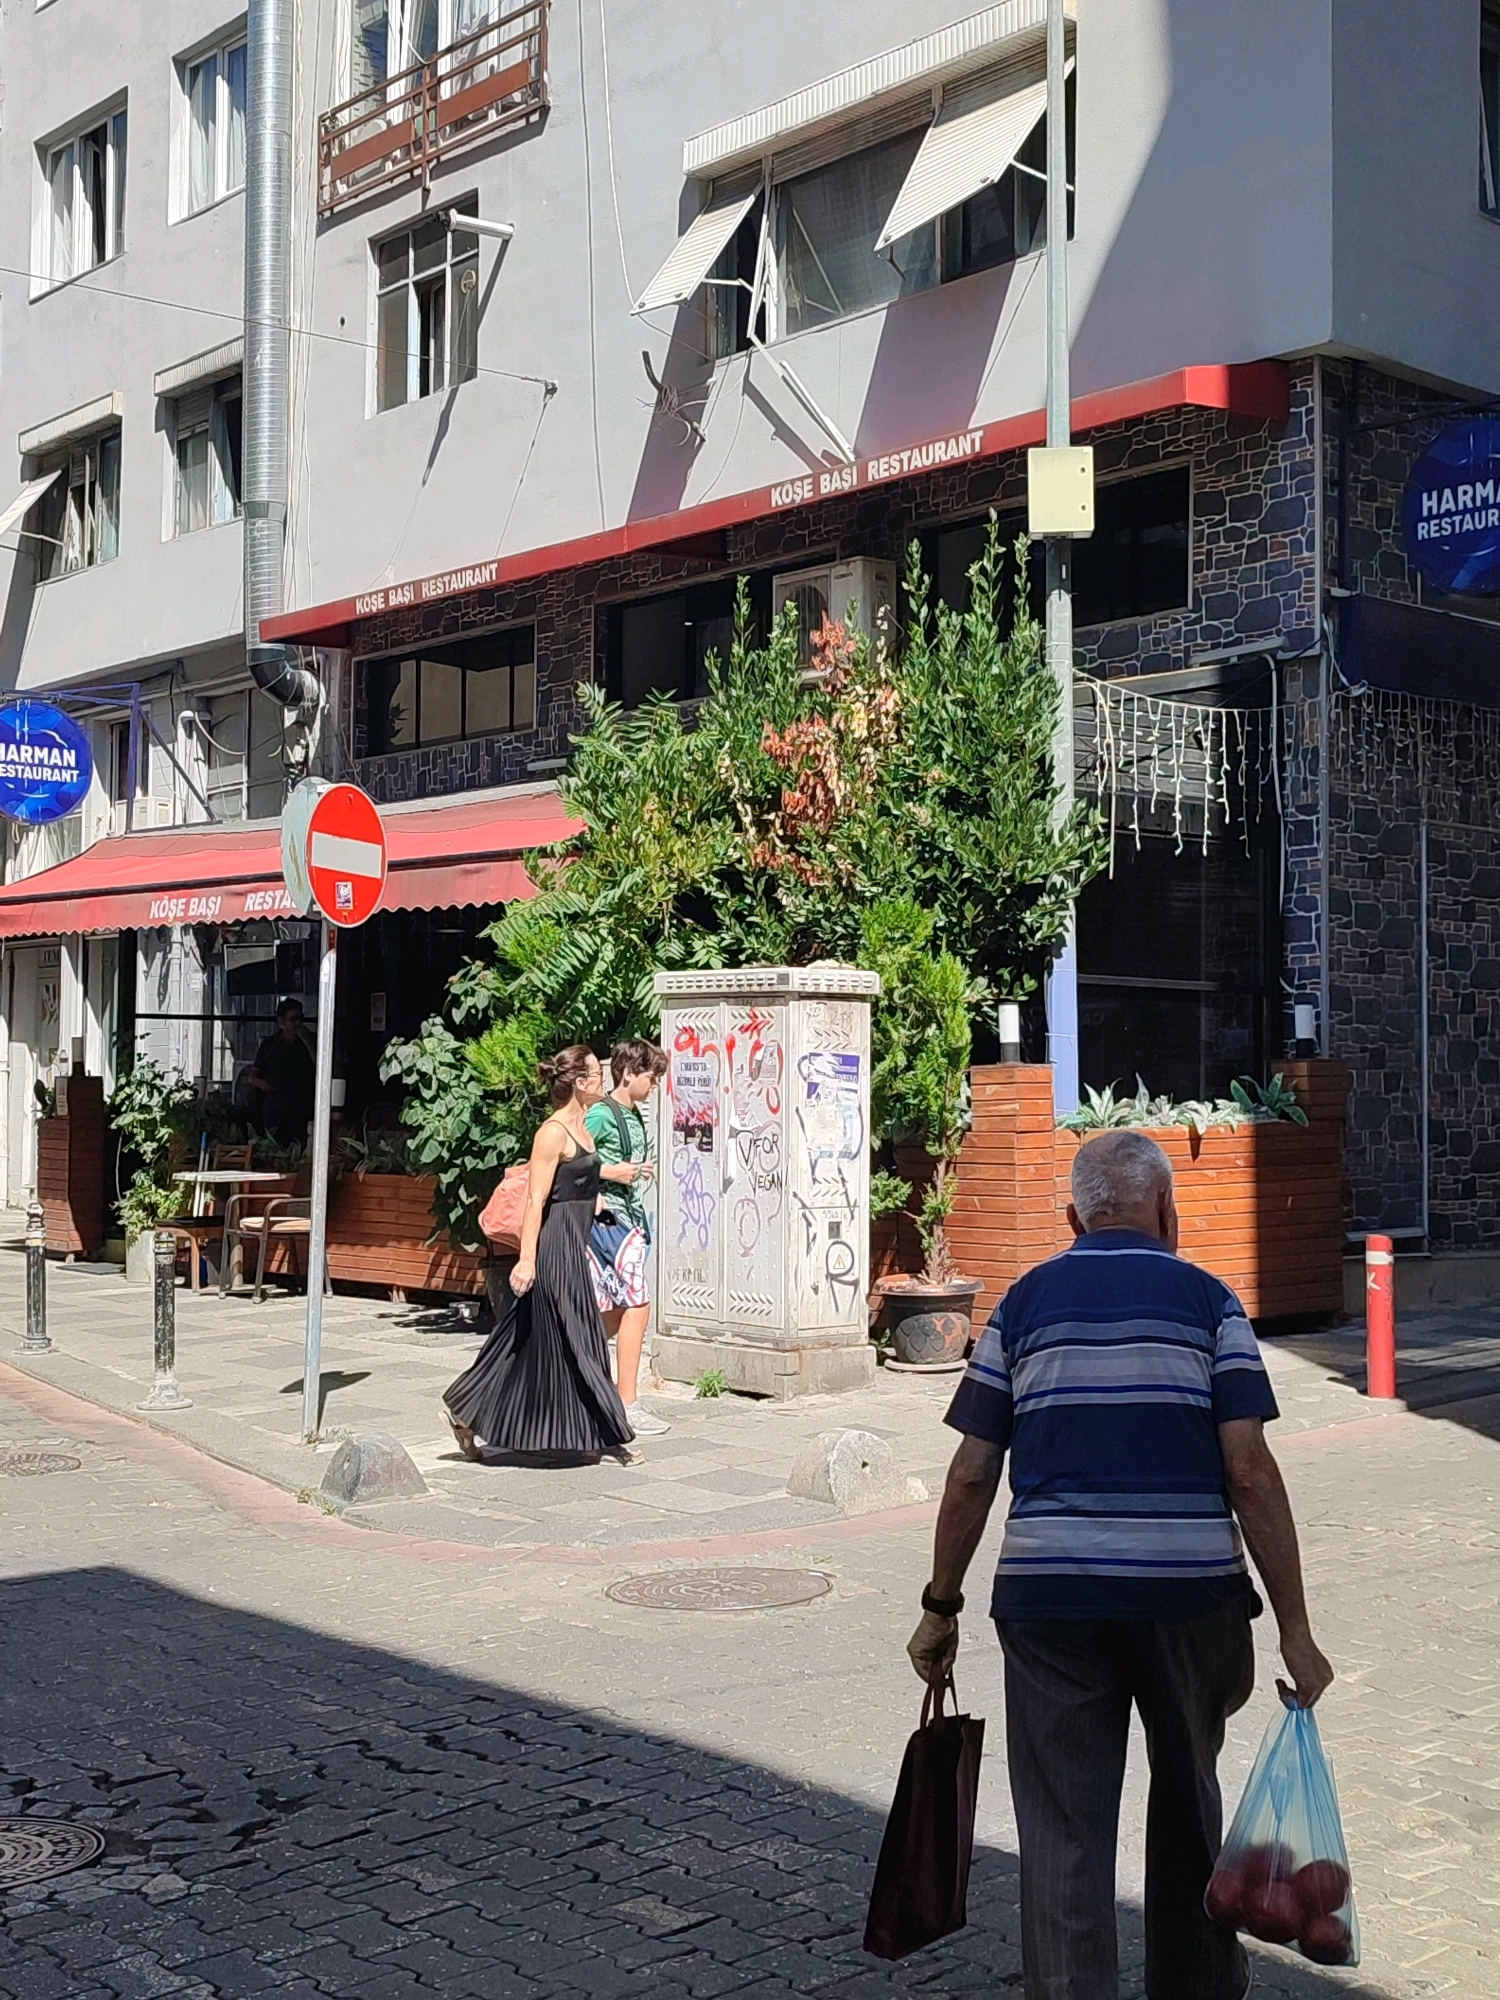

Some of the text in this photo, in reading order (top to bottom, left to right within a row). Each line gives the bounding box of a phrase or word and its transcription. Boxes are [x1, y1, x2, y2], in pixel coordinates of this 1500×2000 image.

[819, 465, 858, 494] BAŞI
[867, 430, 984, 482] RESTAURANT
[1422, 478, 1500, 517] HARM
[388, 583, 415, 607] BAŞI
[421, 563, 498, 599] RESTAURANT
[149, 887, 297, 922] KÖŞE BAŞI RESTA
[753, 1131, 781, 1158] FOR
